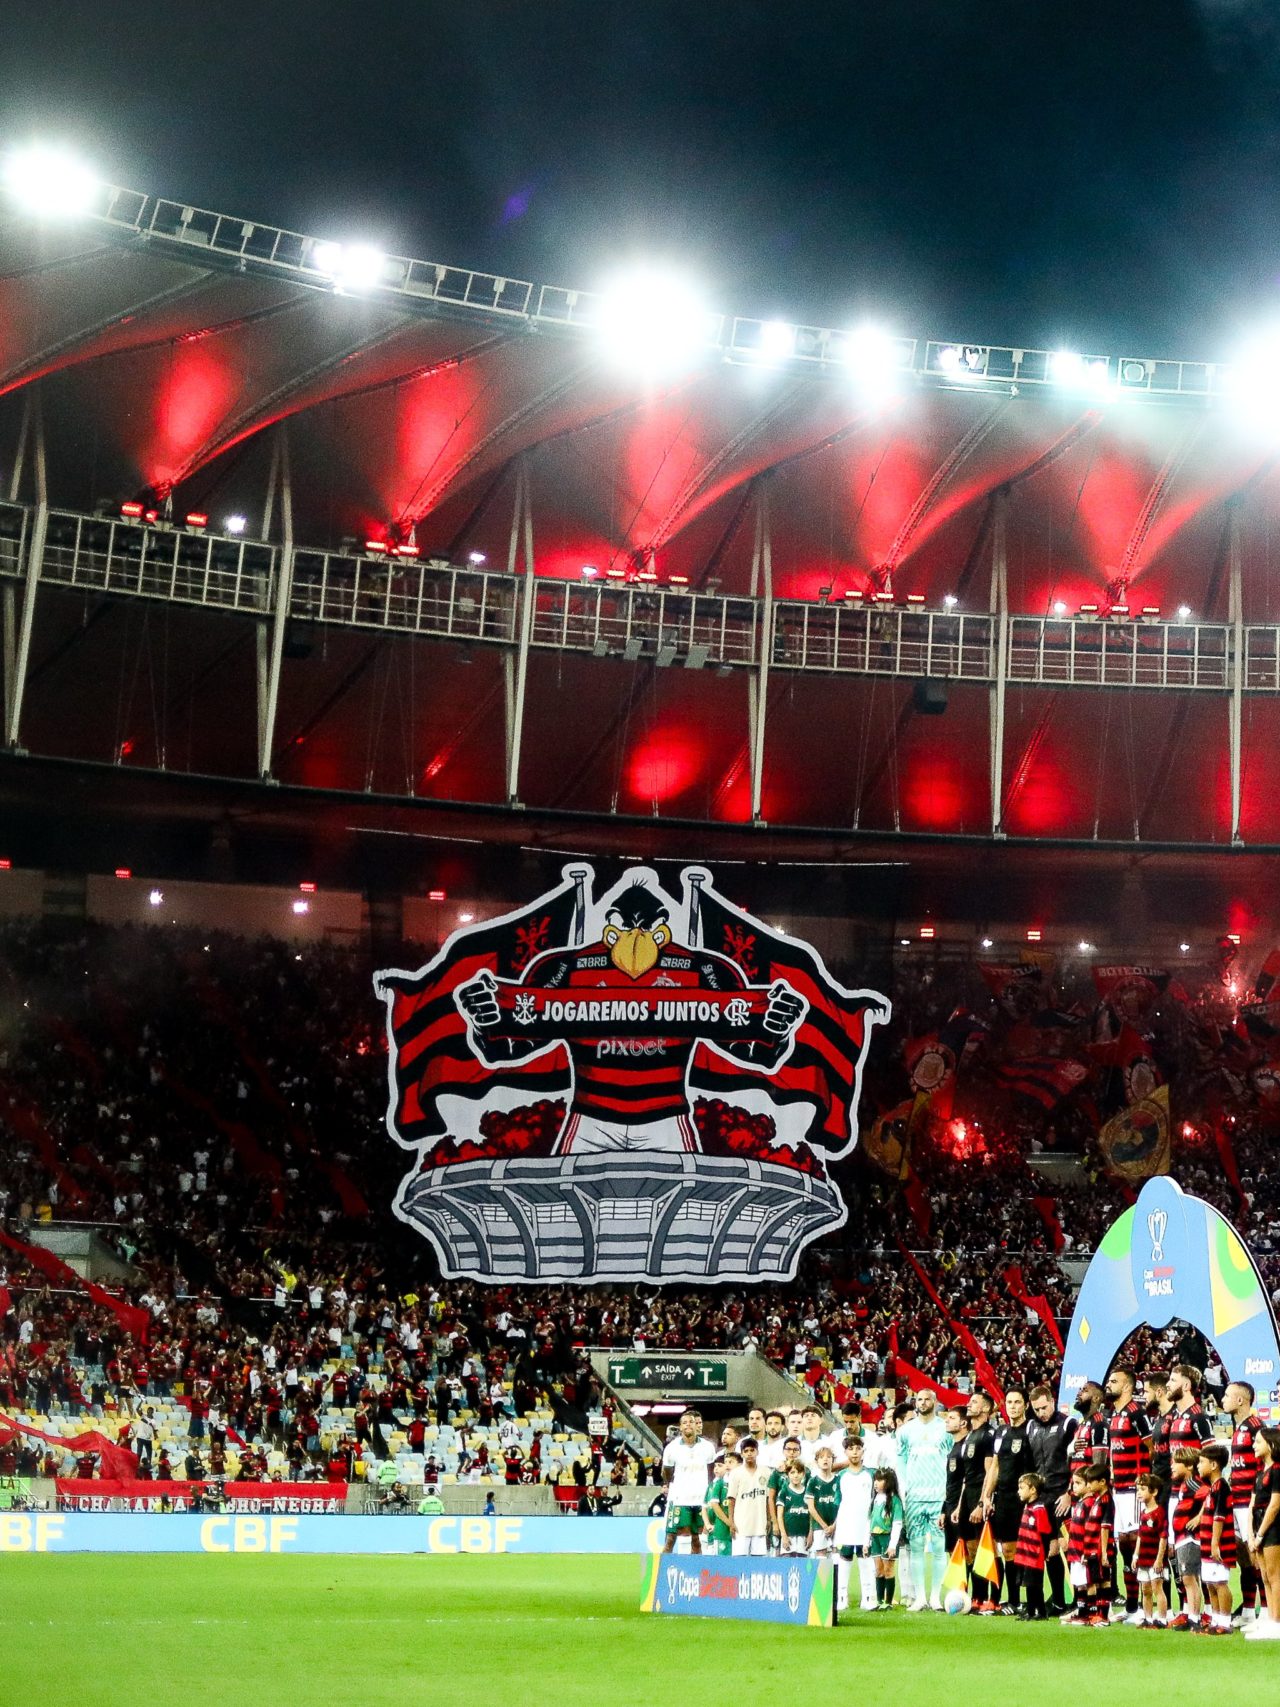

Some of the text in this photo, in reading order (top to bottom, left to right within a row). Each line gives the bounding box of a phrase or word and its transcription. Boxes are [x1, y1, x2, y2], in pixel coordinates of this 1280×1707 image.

[588, 957, 607, 967] BRB
[671, 958, 691, 969] BRB
[542, 1001, 649, 1021] JOGAREMOS
[654, 1001, 720, 1022] JUNTOS
[597, 1038, 667, 1058] pixbet
[611, 1366, 624, 1383] T
[655, 1363, 681, 1373] SAÍDA
[1245, 1358, 1274, 1374] Betano
[700, 1368, 713, 1385] T
[0, 1515, 66, 1552] BF
[200, 1516, 299, 1552] CBF
[428, 1518, 523, 1553] CBF
[679, 1571, 700, 1602] Copa
[738, 1573, 750, 1600] do
[750, 1573, 785, 1601] BRASIL
